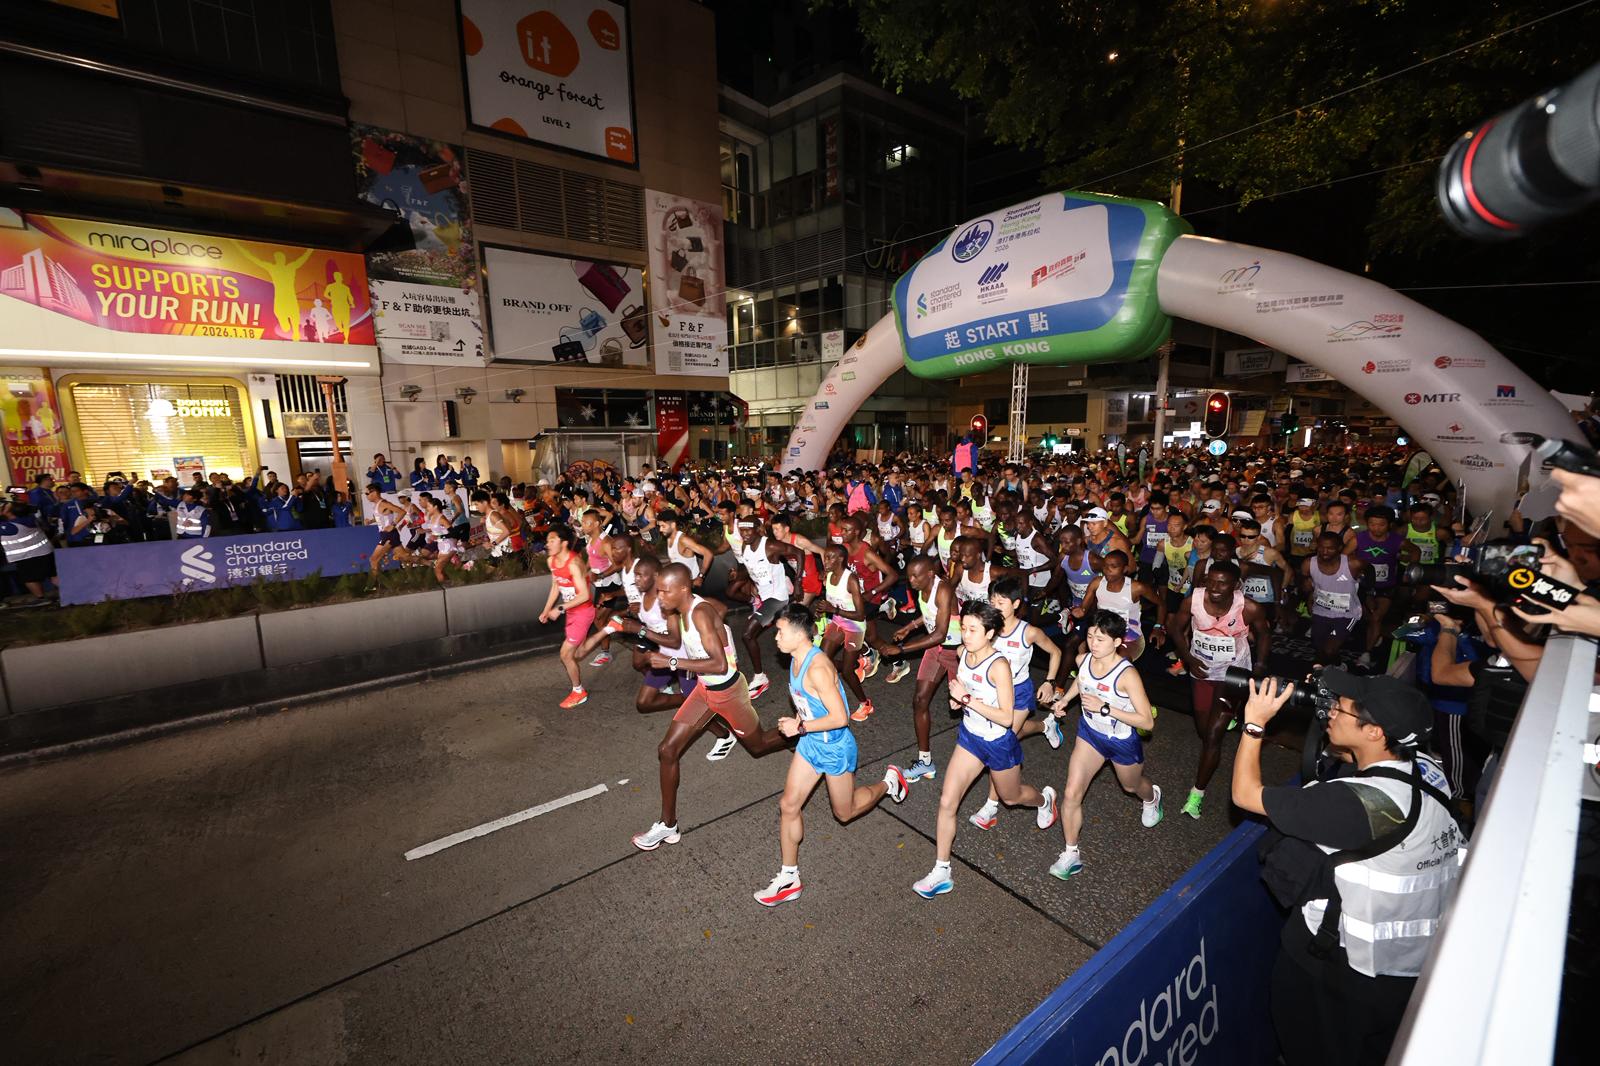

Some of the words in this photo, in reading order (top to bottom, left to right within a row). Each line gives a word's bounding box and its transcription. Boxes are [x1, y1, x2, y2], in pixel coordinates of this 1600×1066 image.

[526, 29, 552, 65] i.t
[499, 71, 554, 101] orange
[557, 83, 605, 111] forest
[542, 115, 564, 128] LEVEL
[1003, 207, 1041, 223] Chartered
[1005, 201, 1041, 217] Standard
[999, 222, 1034, 236] Marathon
[88, 232, 223, 260] miraplace
[994, 244, 1009, 253] 2026
[91, 263, 240, 299] SUPPORTS
[980, 282, 1005, 293] HKAAA
[930, 282, 960, 298] standard
[930, 289, 962, 306] chartered
[96, 290, 180, 322] YOUR
[190, 298, 261, 326] RUN!
[382, 301, 390, 310] F
[392, 302, 402, 312] &
[503, 298, 546, 310] BRAND
[549, 303, 572, 313] OFF
[679, 321, 686, 331] F
[688, 322, 696, 332] &
[698, 323, 704, 332] F
[1028, 311, 1049, 333] 點
[202, 326, 255, 339] 2026.1.18
[966, 319, 1020, 344] START
[944, 330, 961, 350] 起
[953, 348, 996, 367] HONG
[1002, 341, 1051, 357] KONG
[1423, 392, 1461, 403] MTR
[178, 406, 231, 417] DONKI
[9, 445, 65, 455] SUPPORTS
[11, 455, 56, 469] YOUR
[224, 538, 303, 556] standard
[226, 549, 308, 566] chartered
[227, 563, 288, 579] 渣打銀行
[1245, 585, 1266, 593] 2404
[1194, 639, 1234, 653] GEBRE
[1416, 856, 1443, 870] Official
